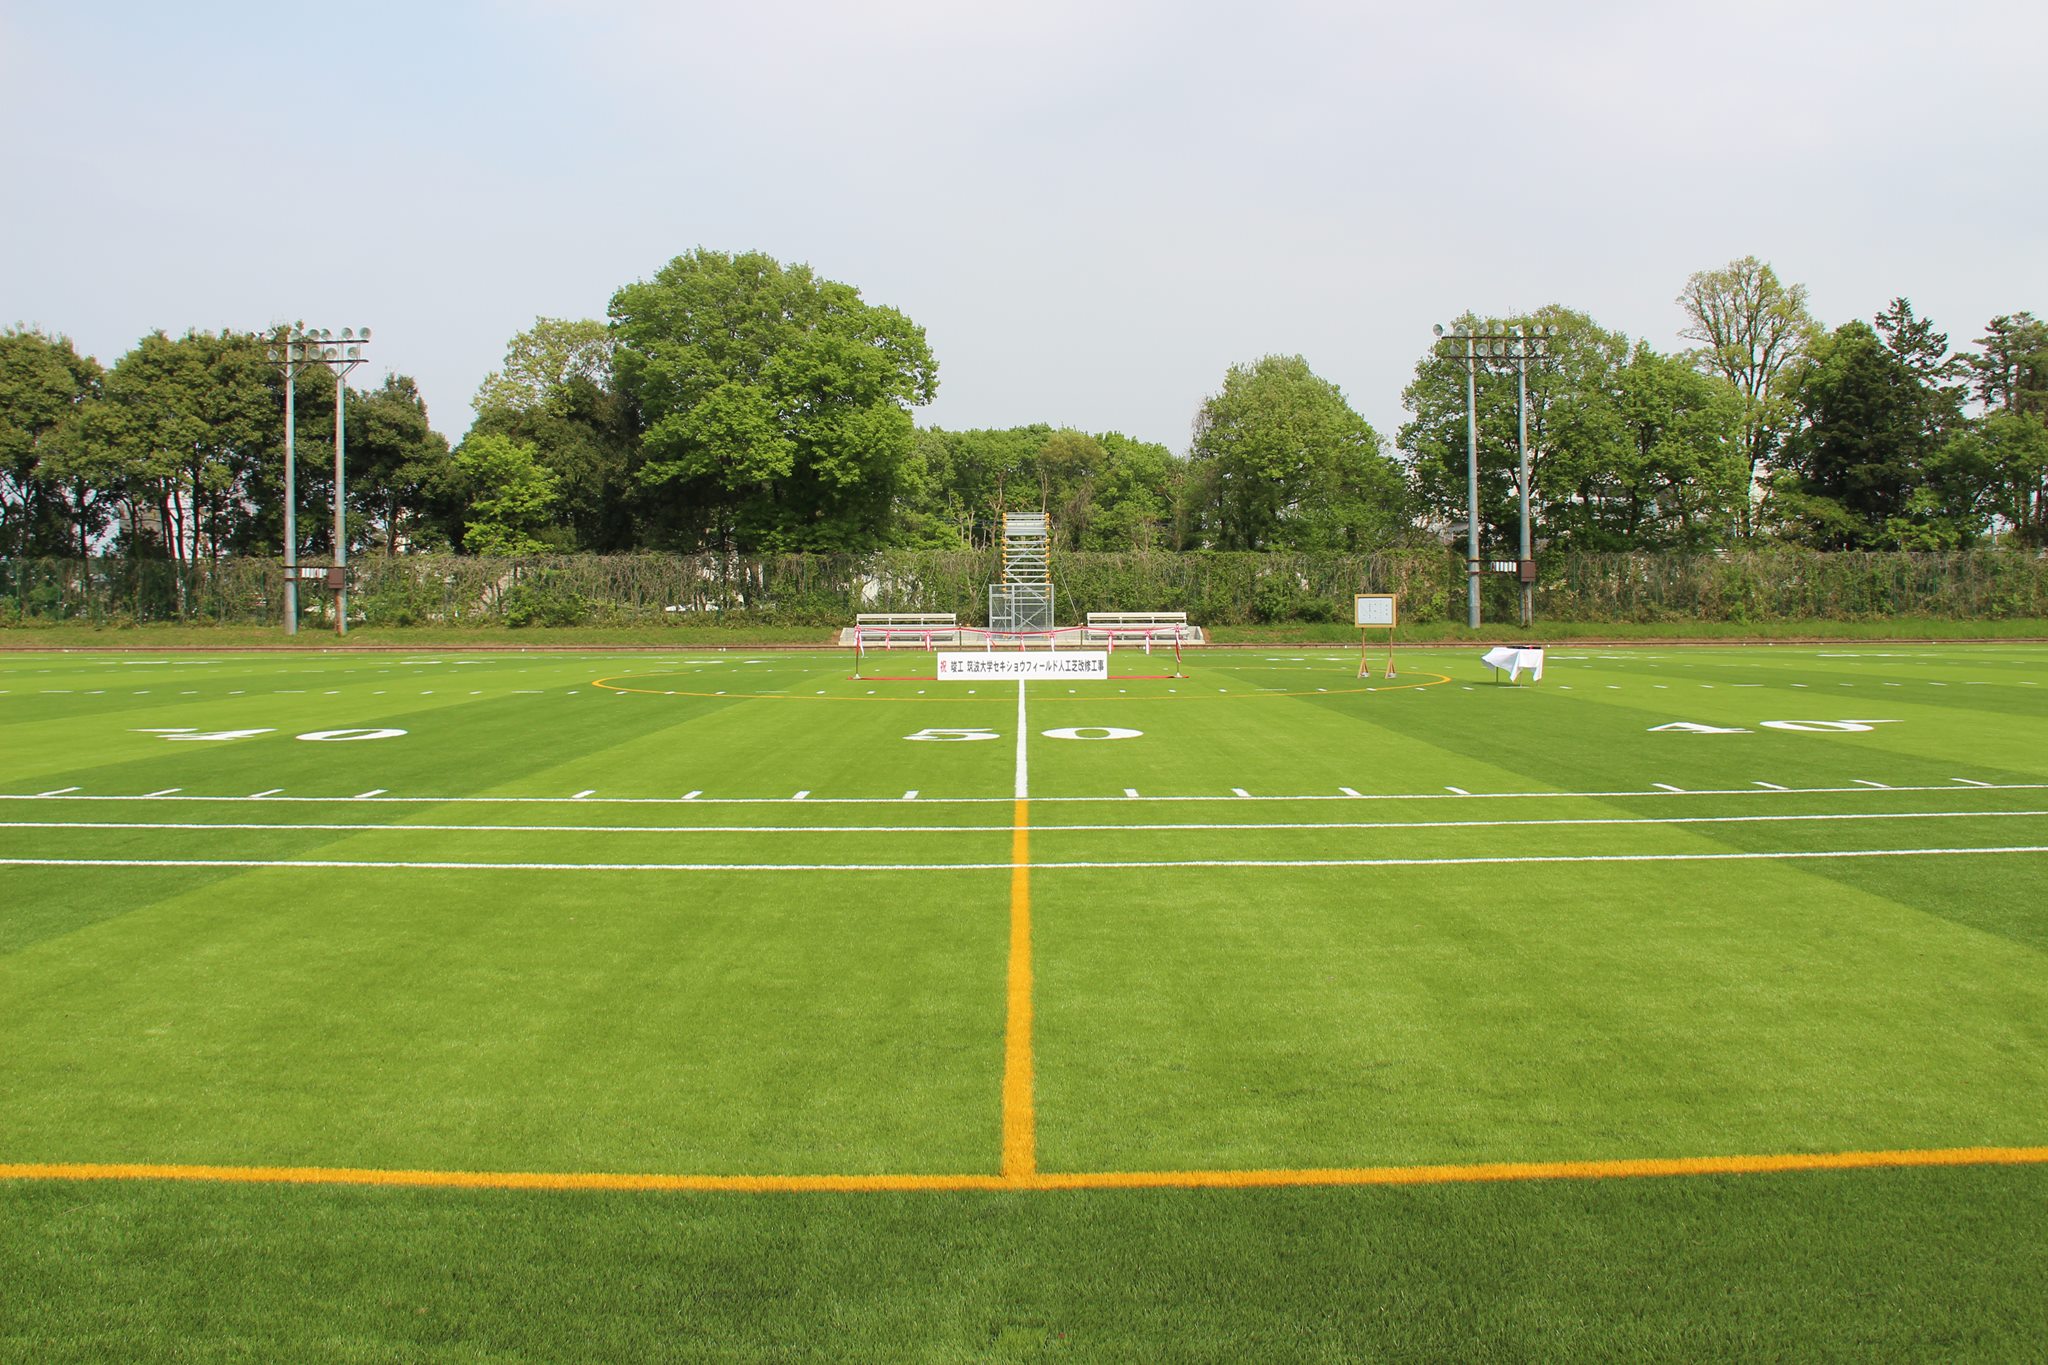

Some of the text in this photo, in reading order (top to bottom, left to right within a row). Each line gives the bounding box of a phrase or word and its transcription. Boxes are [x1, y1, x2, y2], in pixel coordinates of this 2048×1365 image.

[940, 659, 1104, 672] 祝 竣工 筑波大学セキショウフィールド人工芝改修工事
